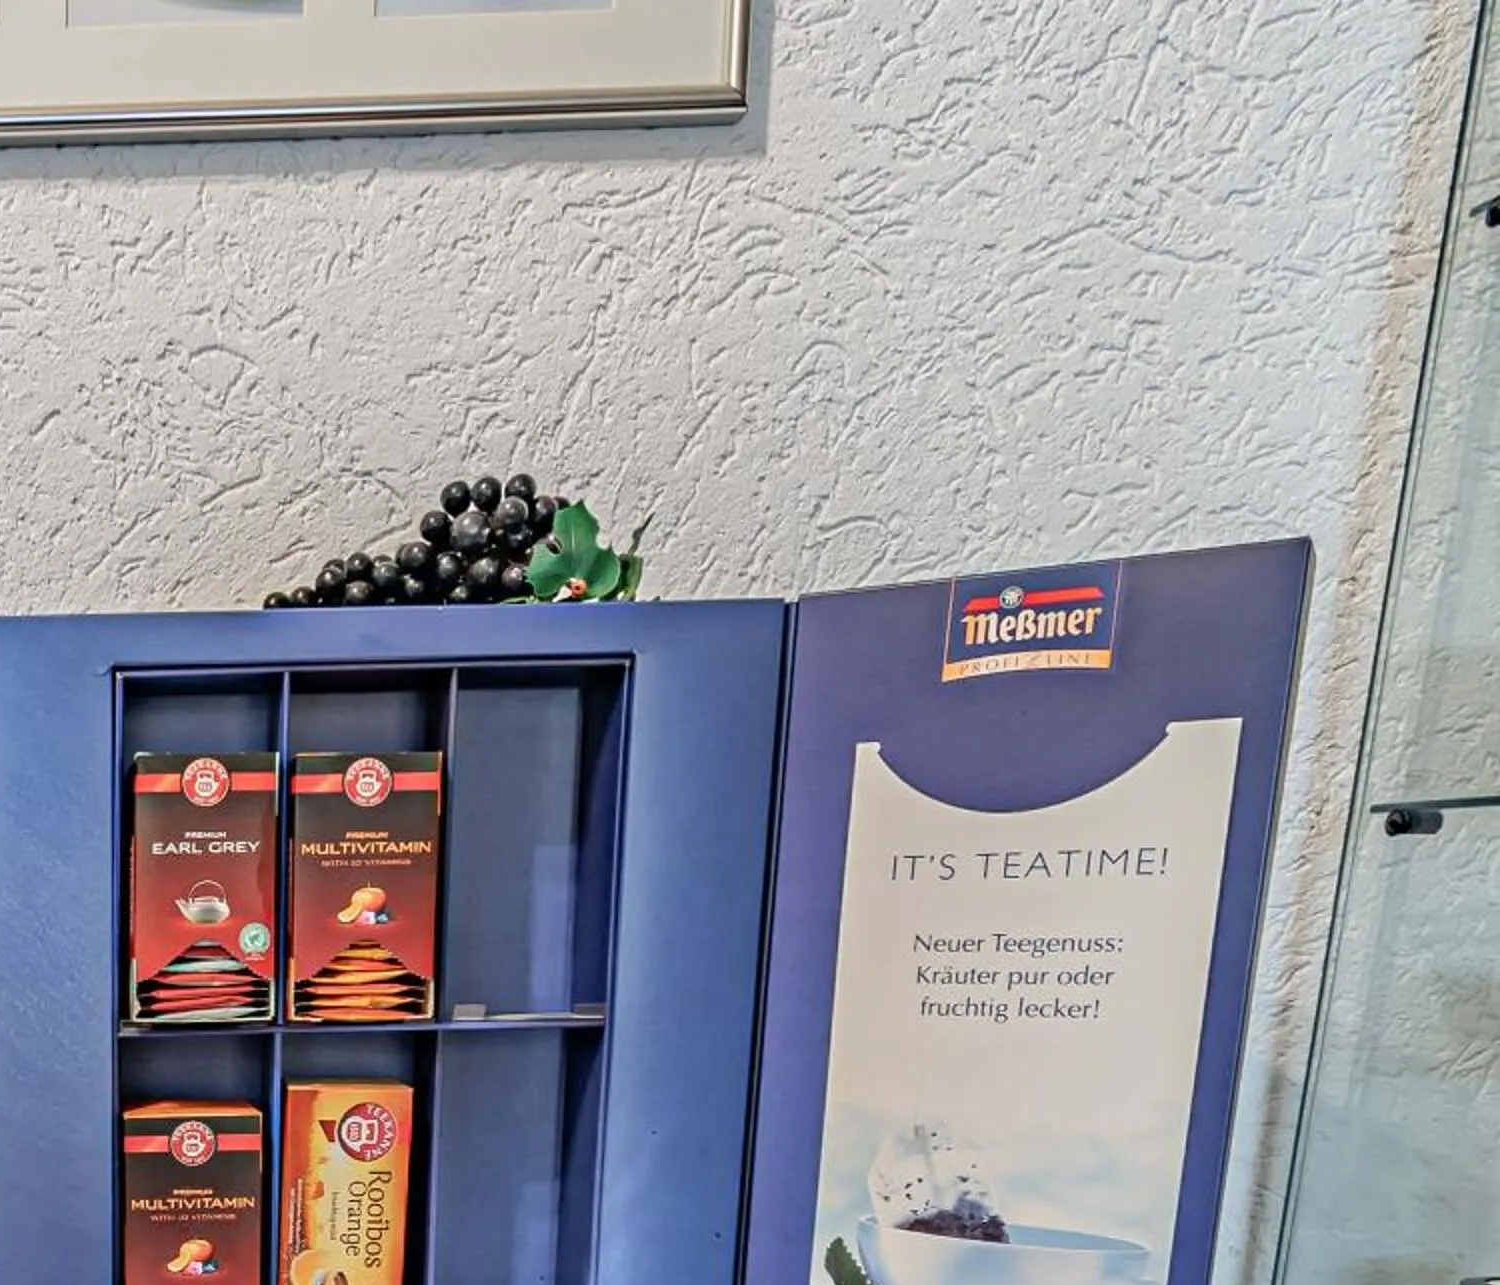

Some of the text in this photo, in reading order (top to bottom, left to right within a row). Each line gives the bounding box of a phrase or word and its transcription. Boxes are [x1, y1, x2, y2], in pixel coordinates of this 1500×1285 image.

[961, 607, 1103, 645] Meßmer
[151, 840, 260, 855] EARL GREY
[301, 841, 432, 855] MULTIVITAMIN
[891, 847, 1169, 881] IT'S TEATIME!
[913, 933, 1124, 958] Neuer Teegenuss:
[916, 965, 1116, 991] Kräuter pur oder
[920, 996, 1100, 1023] fruchtig lecker!
[131, 1197, 256, 1211] MULTIVITAMIN
[339, 1180, 367, 1257] Orange
[363, 1170, 393, 1269] Rooibos
